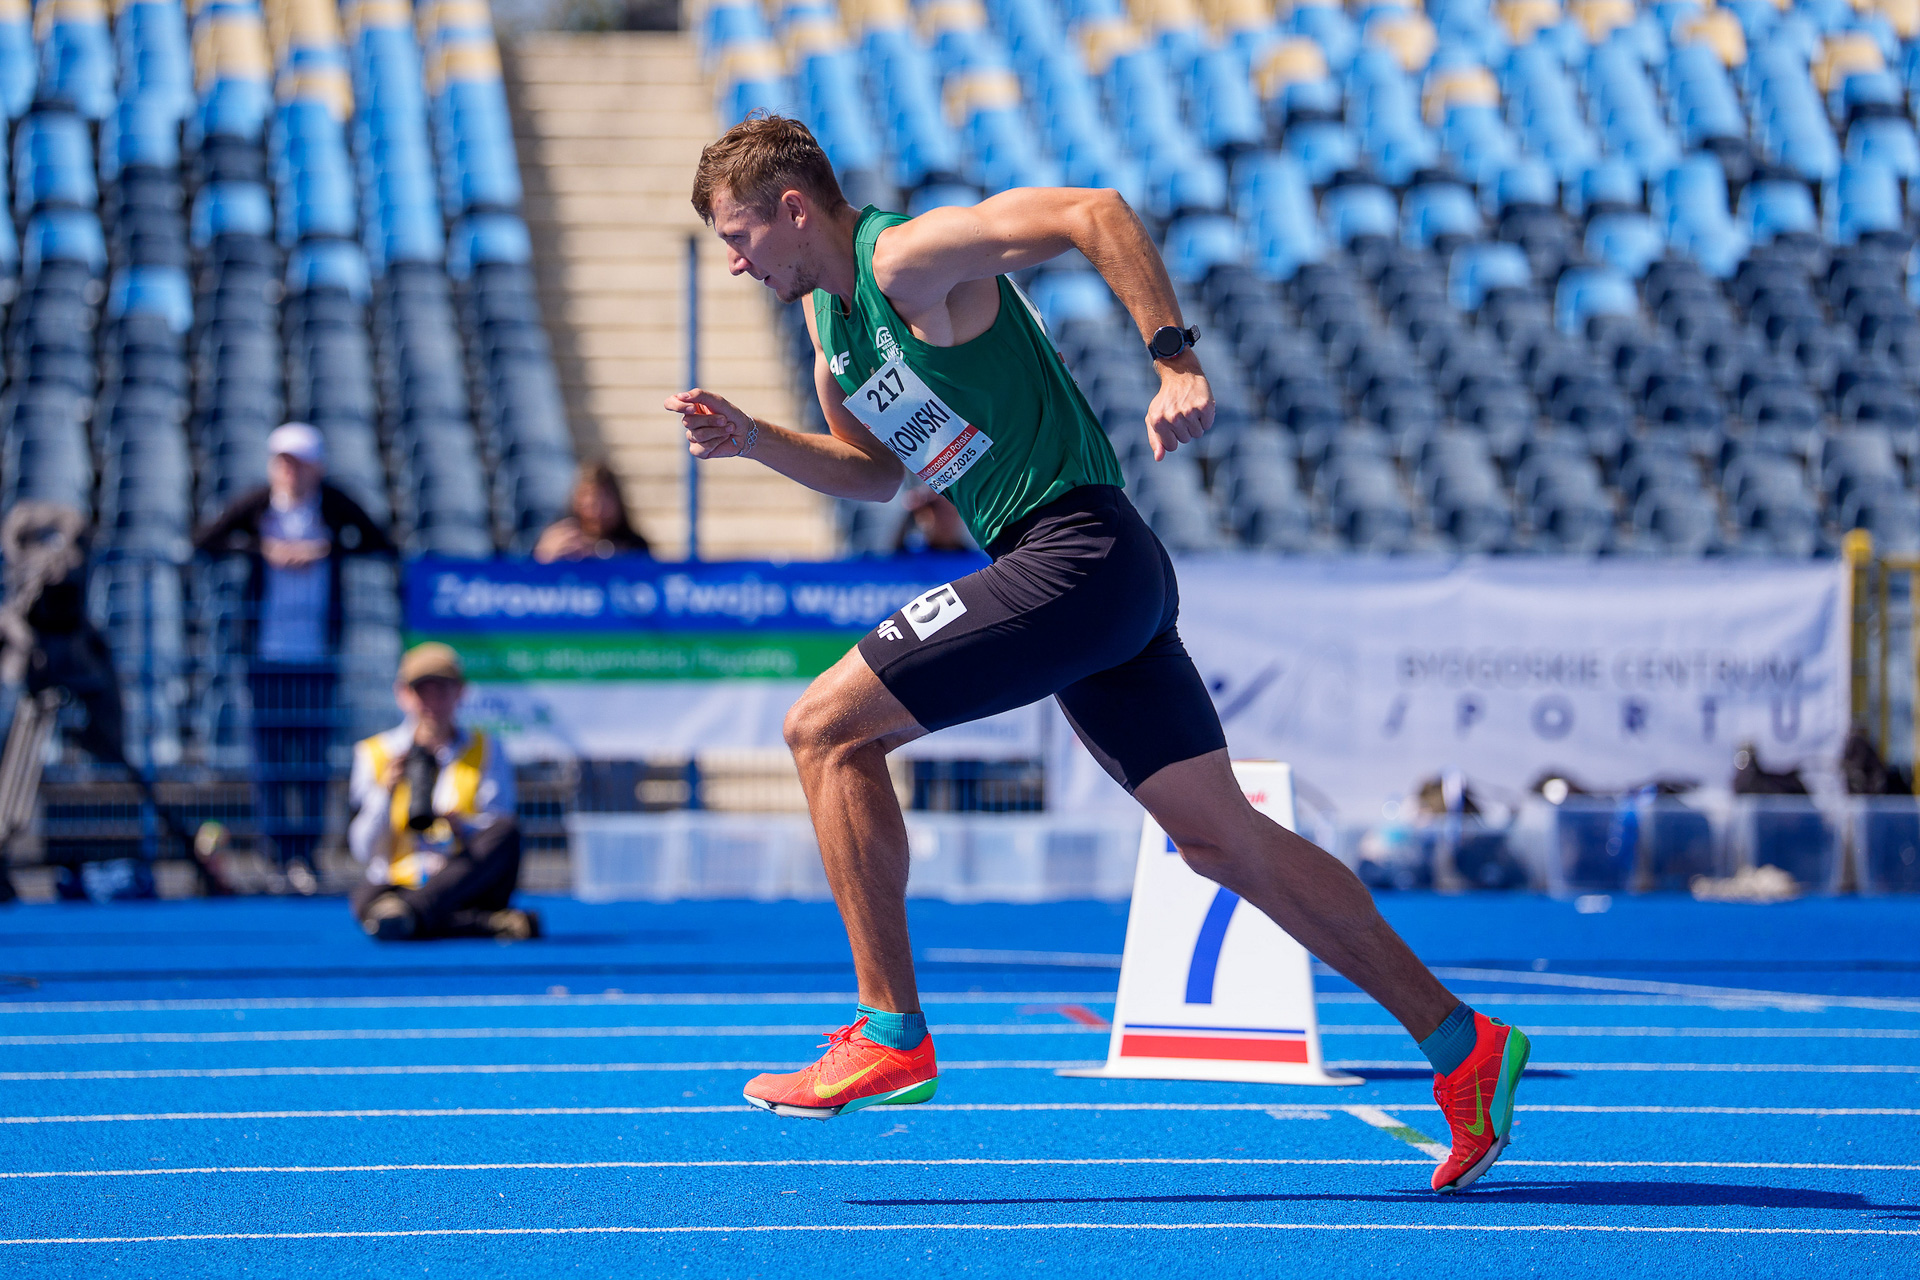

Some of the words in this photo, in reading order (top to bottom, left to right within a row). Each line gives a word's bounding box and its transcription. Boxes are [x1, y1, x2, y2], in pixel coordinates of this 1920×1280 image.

[866, 366, 905, 413] 217
[884, 398, 951, 461] KOWSKI
[921, 450, 954, 479] strzostwa
[949, 430, 973, 453] Polski
[954, 447, 977, 471] 2025
[433, 572, 604, 618] Zdrowie
[909, 588, 957, 623] 5
